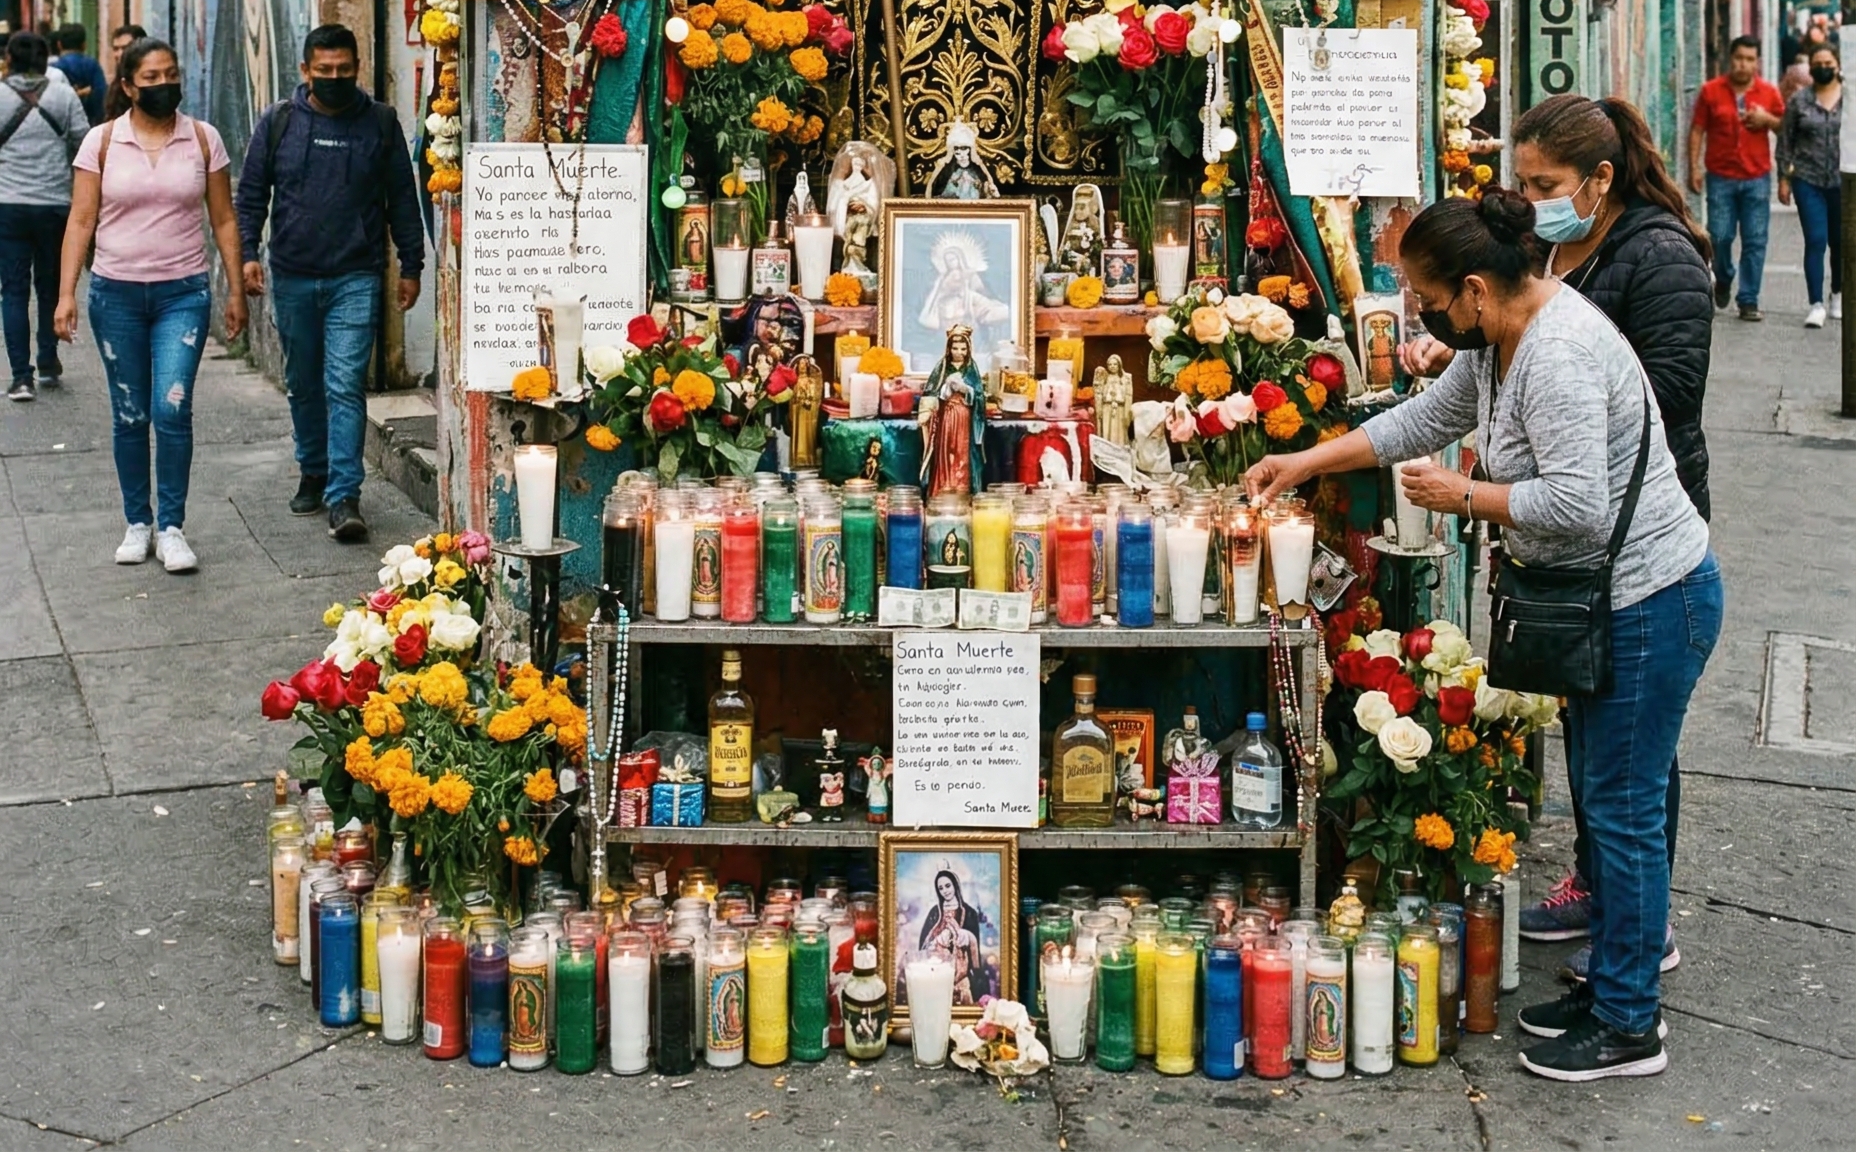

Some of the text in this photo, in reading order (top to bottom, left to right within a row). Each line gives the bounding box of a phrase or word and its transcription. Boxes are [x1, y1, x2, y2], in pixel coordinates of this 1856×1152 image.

[478, 155, 534, 179] Santa
[897, 640, 1014, 659] Santa Muerte
[964, 801, 996, 813] Santa
